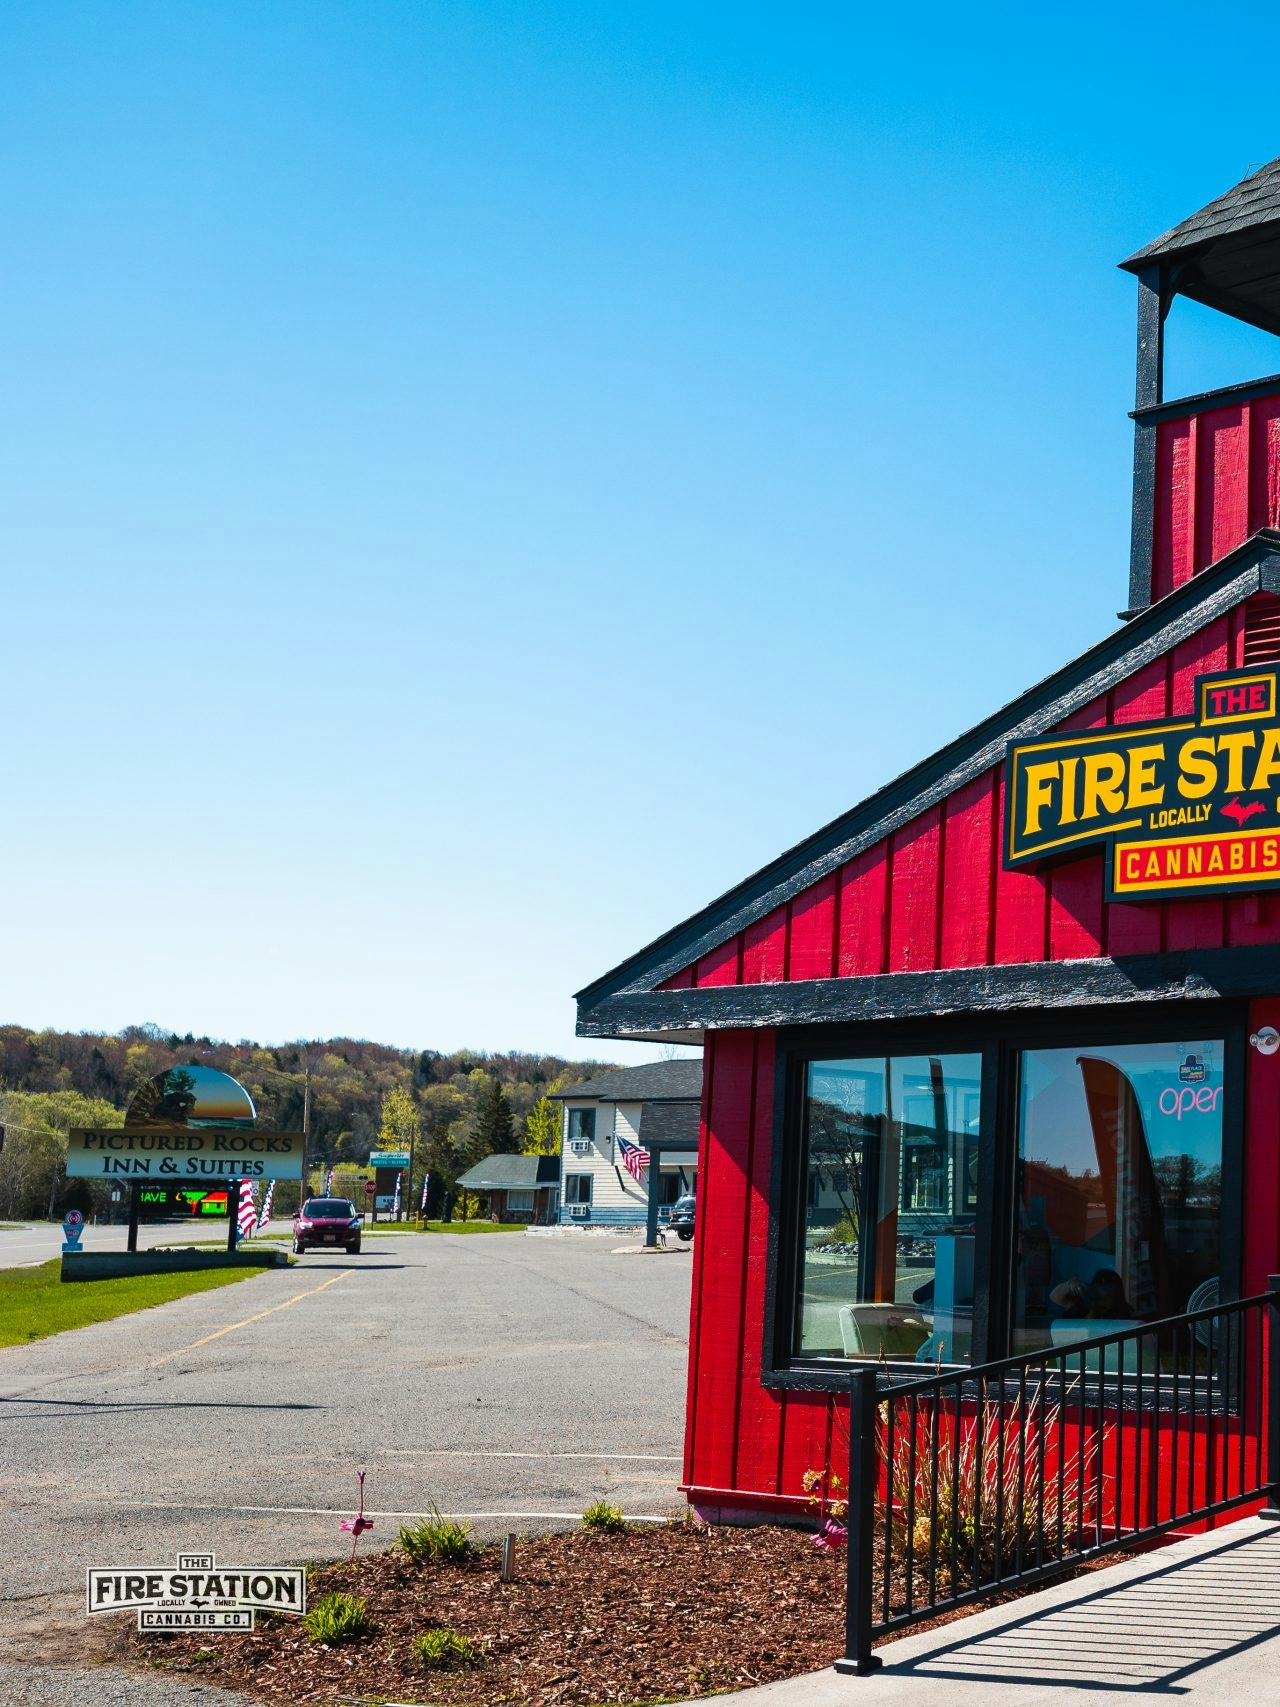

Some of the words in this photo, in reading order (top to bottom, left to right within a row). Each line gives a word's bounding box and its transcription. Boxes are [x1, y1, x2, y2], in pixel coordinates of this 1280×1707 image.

[1210, 684, 1266, 715] THE
[1022, 743, 1168, 836] FIRE
[1149, 803, 1213, 830] LOCALLY
[1126, 839, 1279, 880] CANNABIS
[82, 1131, 204, 1151] PICTURED
[213, 1134, 293, 1153] ROCKS
[102, 1156, 152, 1173] INN
[159, 1157, 180, 1174] &
[186, 1157, 265, 1175] SUITES
